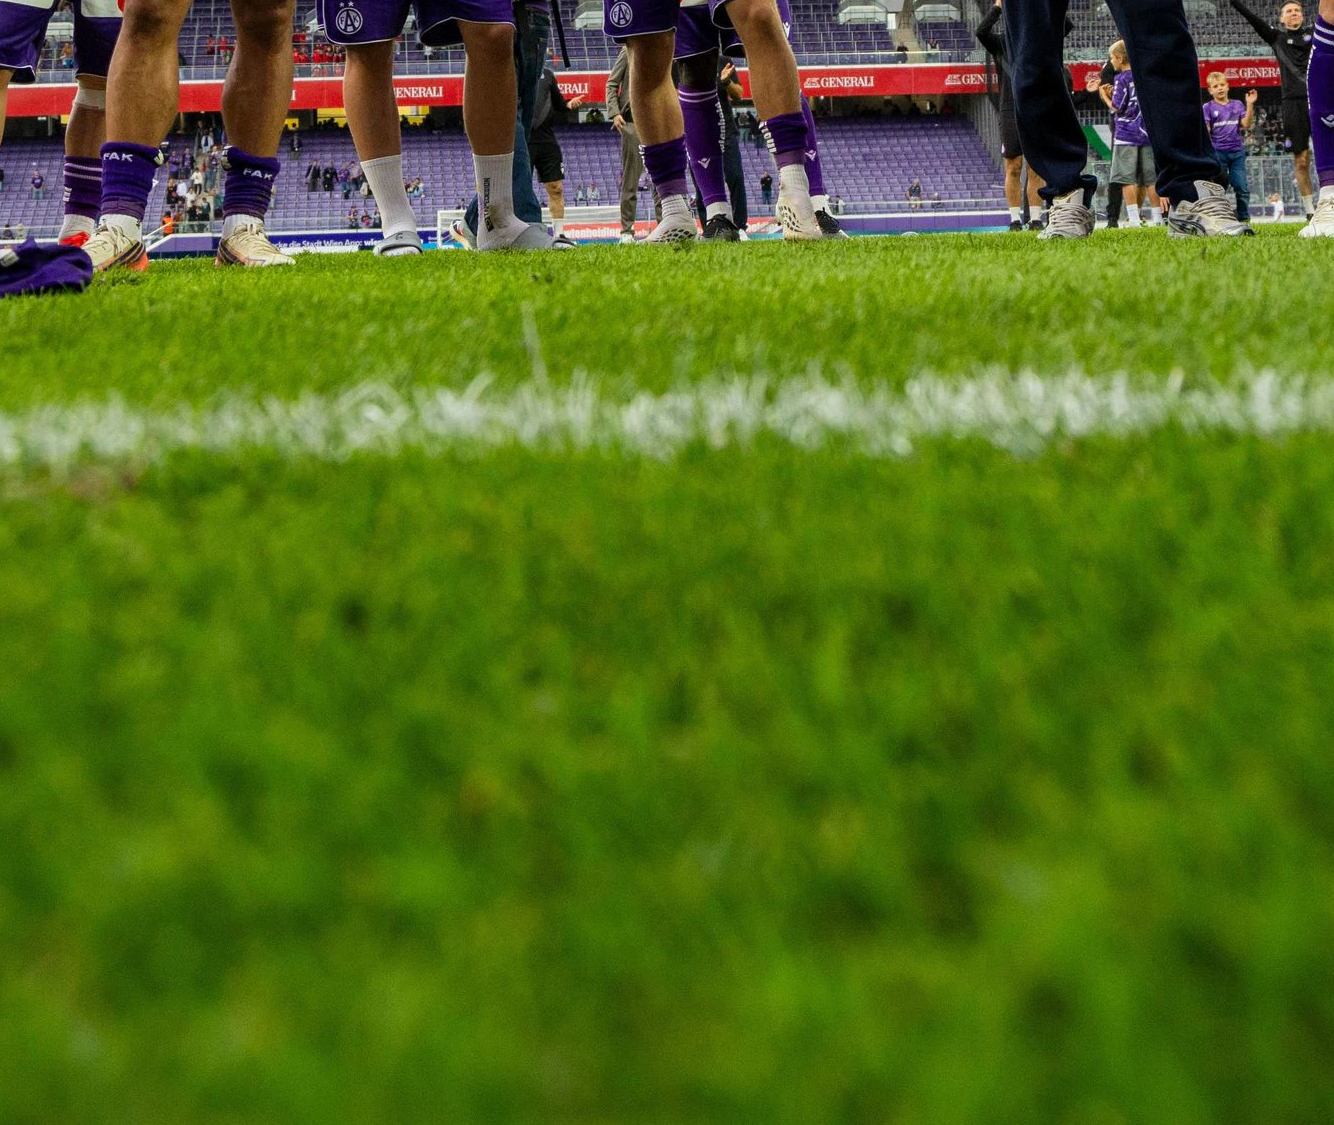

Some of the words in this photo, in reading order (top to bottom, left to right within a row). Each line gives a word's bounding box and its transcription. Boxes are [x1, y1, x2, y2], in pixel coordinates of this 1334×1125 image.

[1239, 66, 1281, 78] GENERA
[820, 75, 875, 88] GENERALI
[394, 86, 444, 99] ENERALI
[557, 82, 589, 94] ERALI
[103, 152, 133, 163] FAK
[243, 168, 273, 181] FAK
